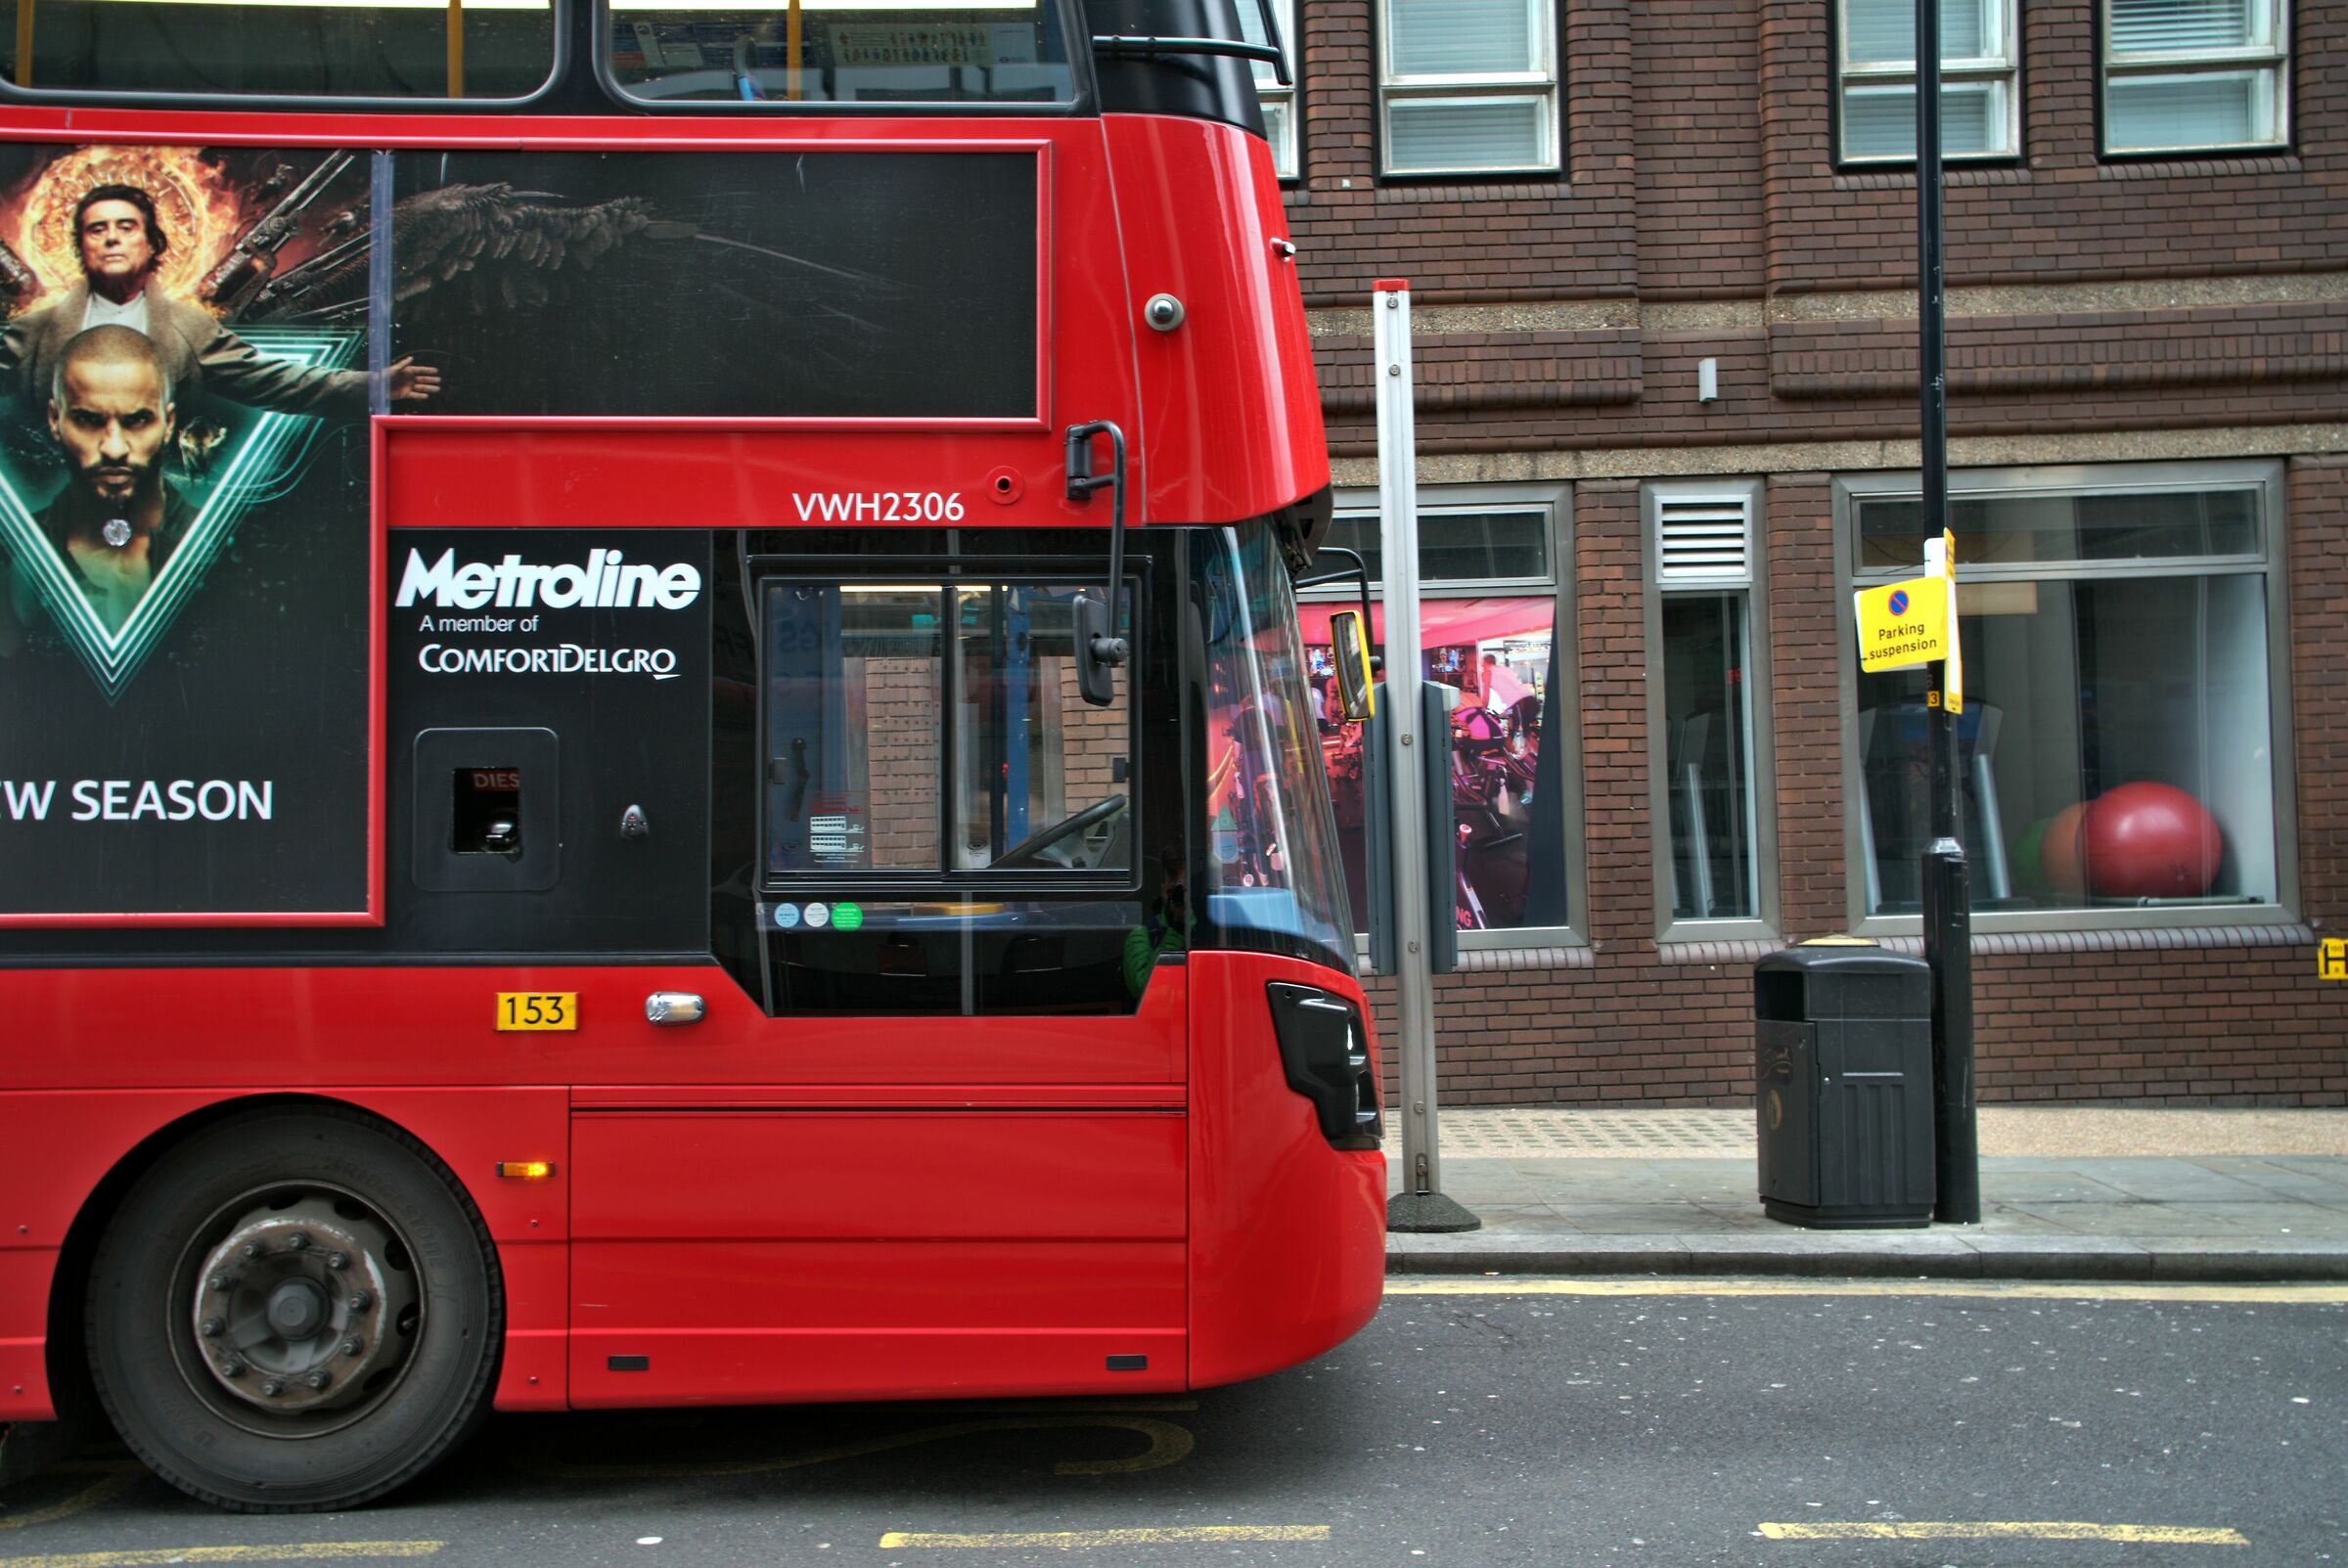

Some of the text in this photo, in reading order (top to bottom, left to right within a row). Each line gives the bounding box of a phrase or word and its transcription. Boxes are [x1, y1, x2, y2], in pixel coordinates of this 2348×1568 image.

[791, 492, 965, 521] VWH2306
[394, 547, 701, 610] Metroline
[419, 614, 540, 632] A member of
[1878, 623, 1924, 641] Parking
[1870, 638, 1937, 660] suspension
[0, 780, 273, 821] W SEASON
[507, 996, 564, 1024] 153
